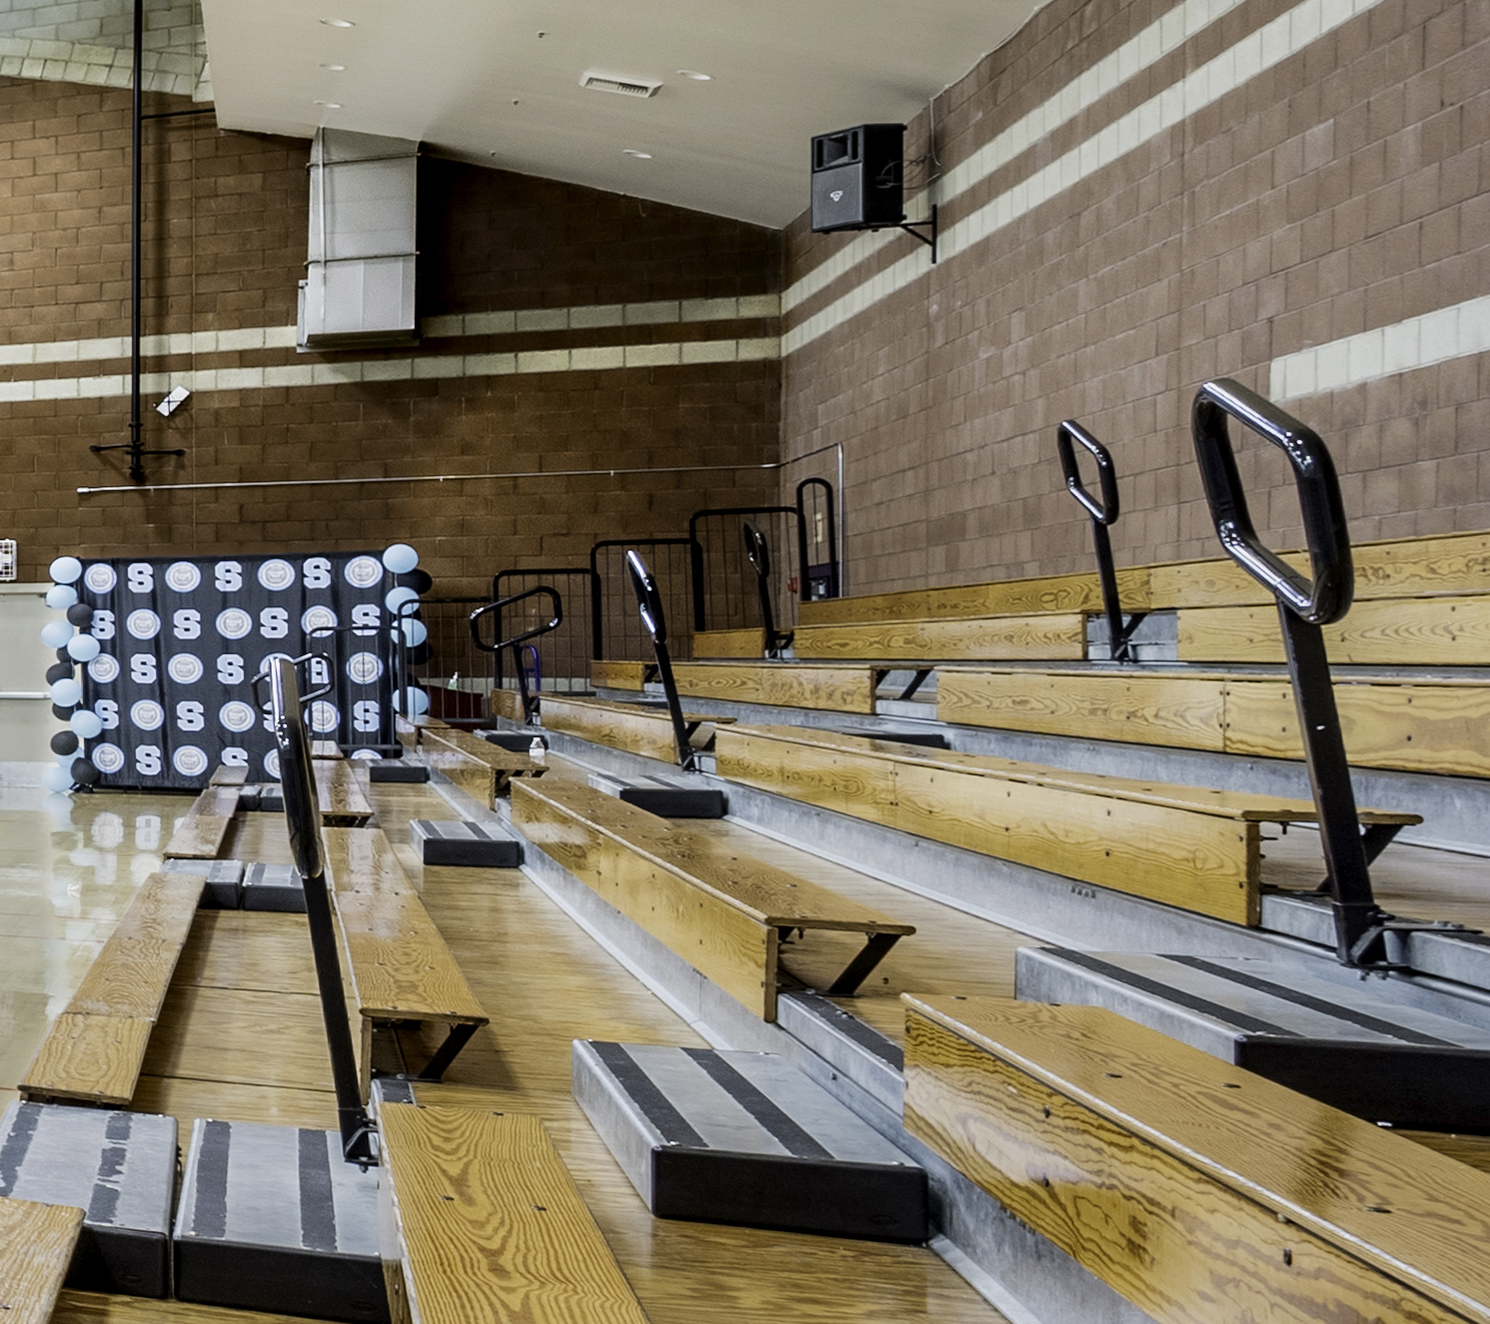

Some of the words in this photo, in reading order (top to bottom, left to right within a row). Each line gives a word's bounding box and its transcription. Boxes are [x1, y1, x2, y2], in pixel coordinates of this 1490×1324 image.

[127, 562, 154, 593] S
[214, 561, 242, 592] S
[303, 557, 331, 589] S
[173, 609, 201, 640] S
[260, 607, 288, 639] S
[131, 654, 156, 684] S
[217, 654, 244, 685] S
[94, 699, 119, 730] S
[176, 701, 204, 731] S
[353, 700, 380, 732] S
[135, 745, 161, 775] S
